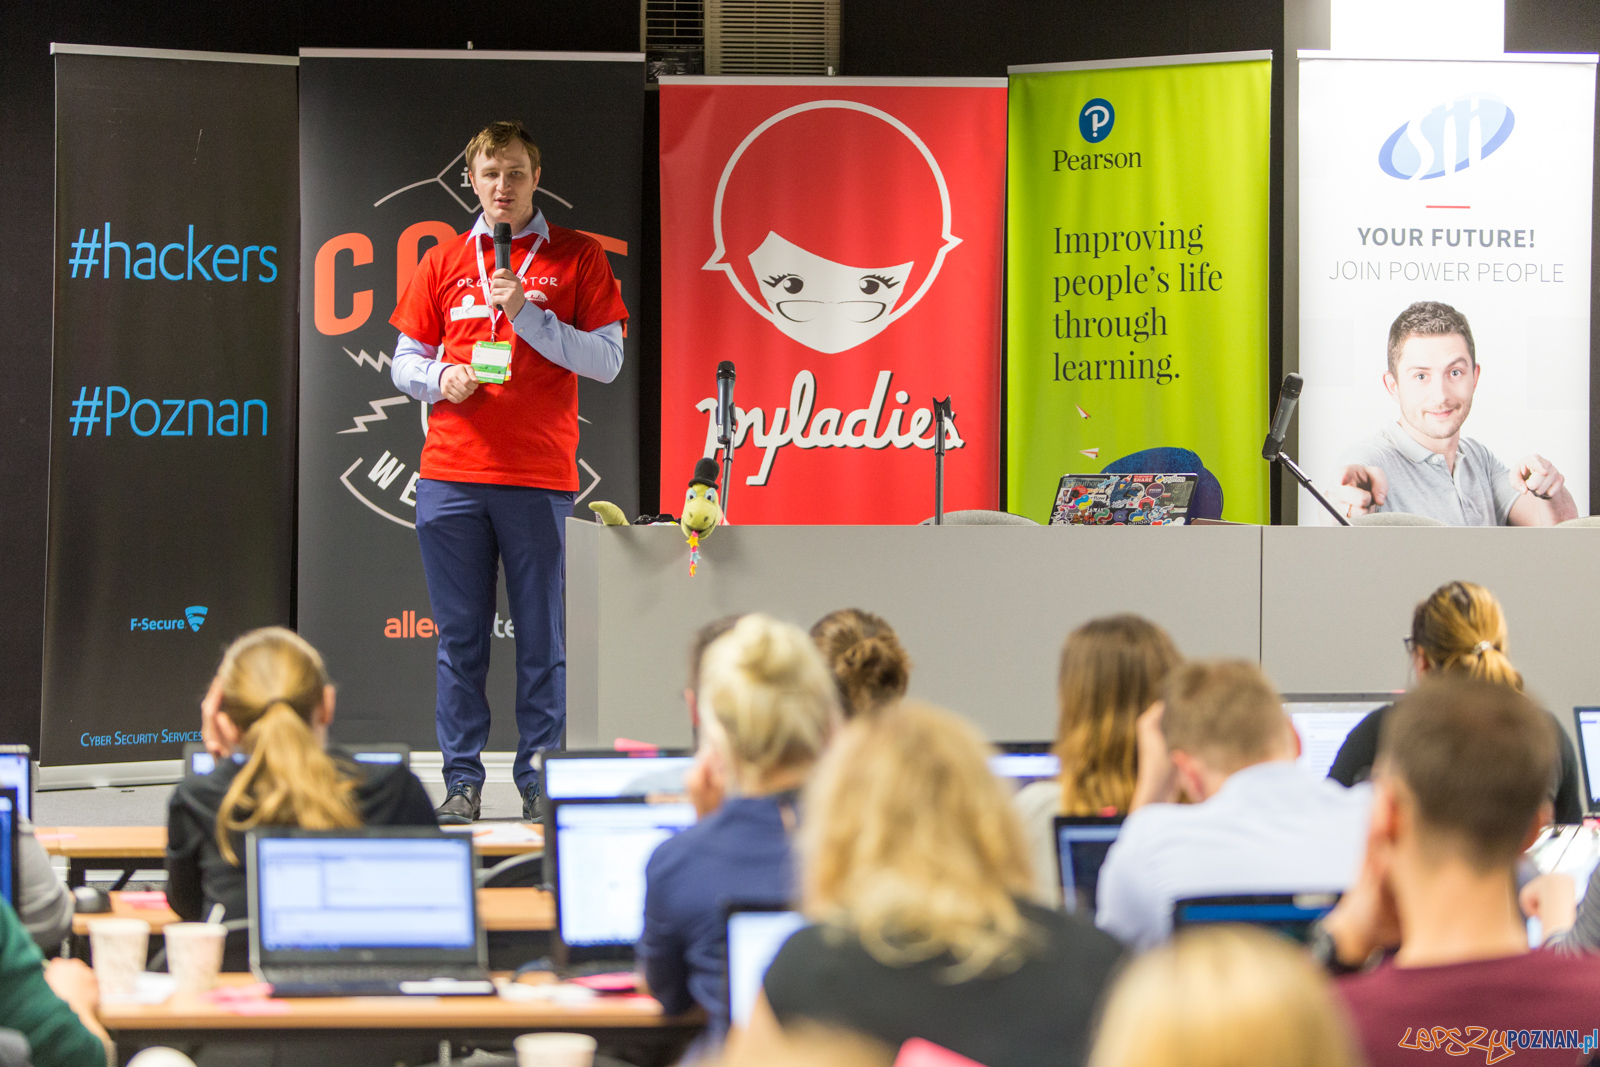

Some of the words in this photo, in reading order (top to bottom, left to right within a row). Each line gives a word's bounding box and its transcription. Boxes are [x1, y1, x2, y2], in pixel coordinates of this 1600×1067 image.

[1052, 149, 1143, 172] Pearson
[68, 221, 278, 283] #hackers
[1053, 221, 1204, 259] Improving
[1357, 227, 1424, 247] YOUR
[1431, 228, 1535, 248] FUTURE!
[1053, 265, 1170, 303] people's
[1179, 262, 1223, 292] life
[1328, 261, 1381, 281] JOIN
[1389, 261, 1470, 282] POWER
[1477, 262, 1565, 283] PEOPLE
[1053, 306, 1168, 343] through
[1052, 350, 1180, 386] learning.
[69, 385, 268, 437] #Poznan
[129, 617, 185, 632] F-Secure
[384, 610, 439, 639] alle
[114, 730, 159, 746] SECURITY
